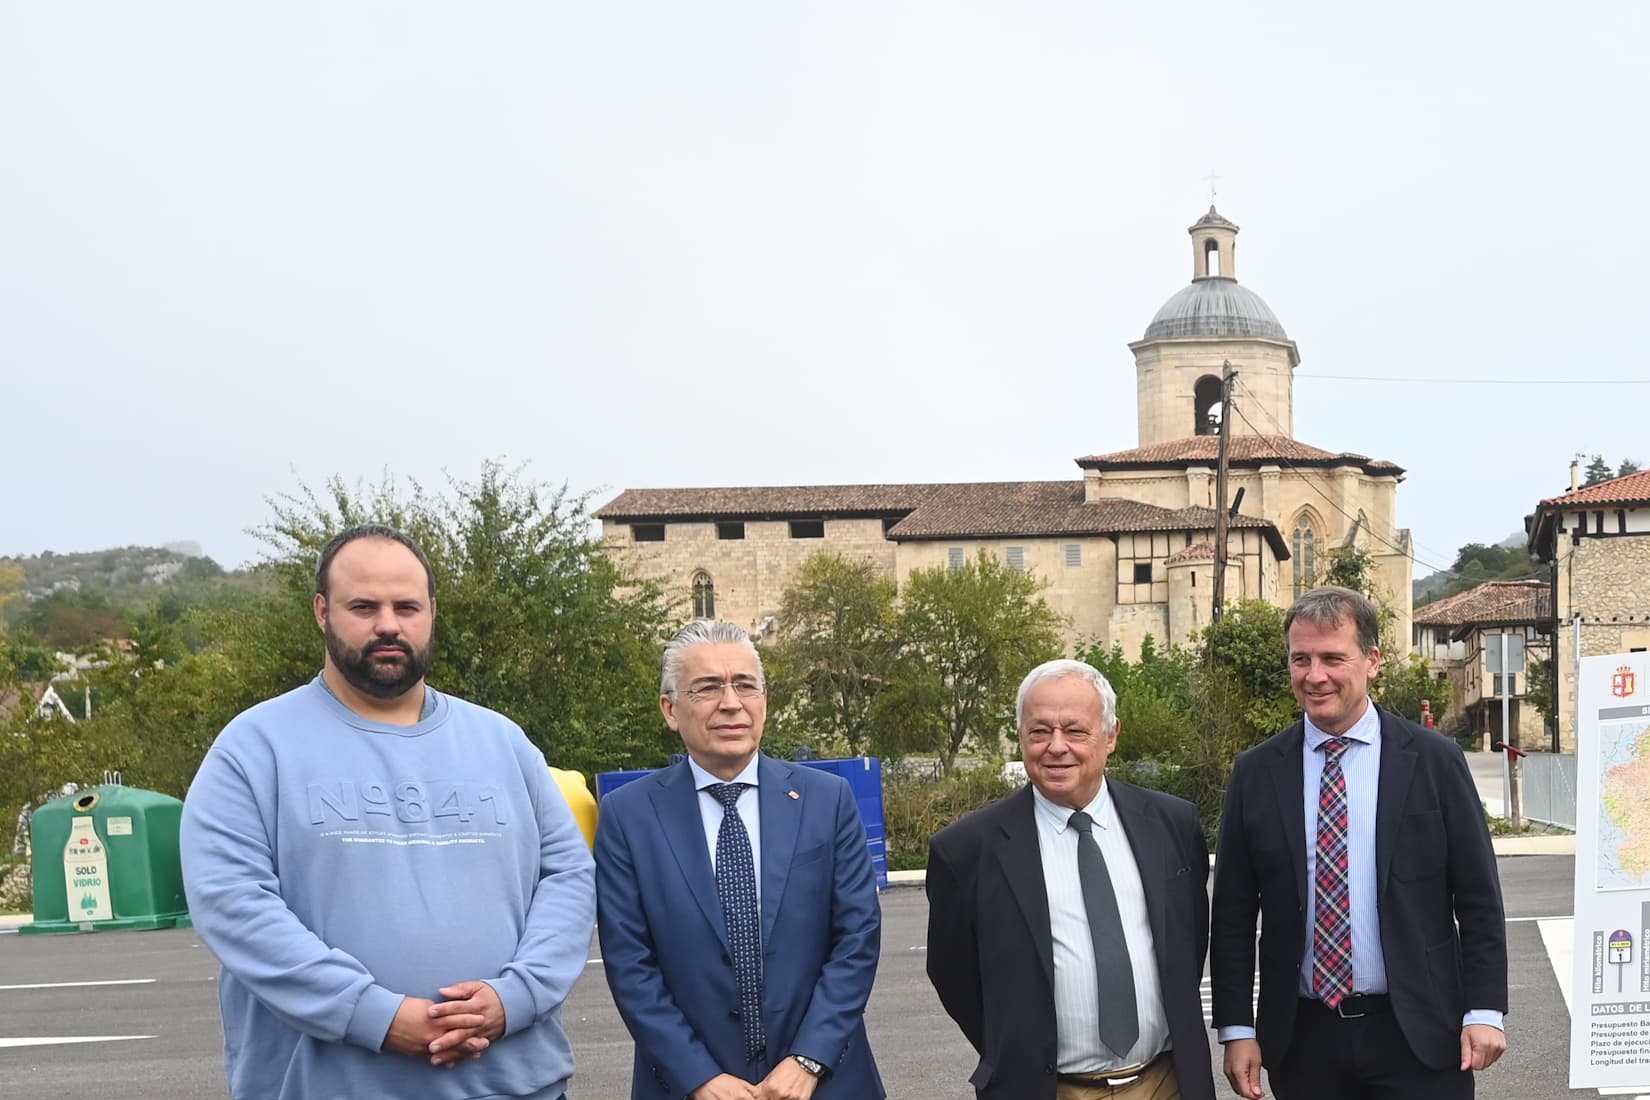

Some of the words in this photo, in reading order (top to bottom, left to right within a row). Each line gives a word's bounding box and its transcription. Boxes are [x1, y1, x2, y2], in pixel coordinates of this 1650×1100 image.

[75, 866, 97, 876] SOLO
[73, 878, 101, 888] VIDRIO
[1592, 1004, 1624, 1015] DATOS
[1629, 1003, 1642, 1013] DE
[1591, 1021, 1638, 1030] Presupuesto
[1591, 1030, 1638, 1039] Presupuesto
[1590, 1039, 1611, 1047] Plazo
[1590, 1048, 1638, 1057] Presupuesto
[1590, 1057, 1624, 1066] Longitud
[1625, 1057, 1637, 1065] del
